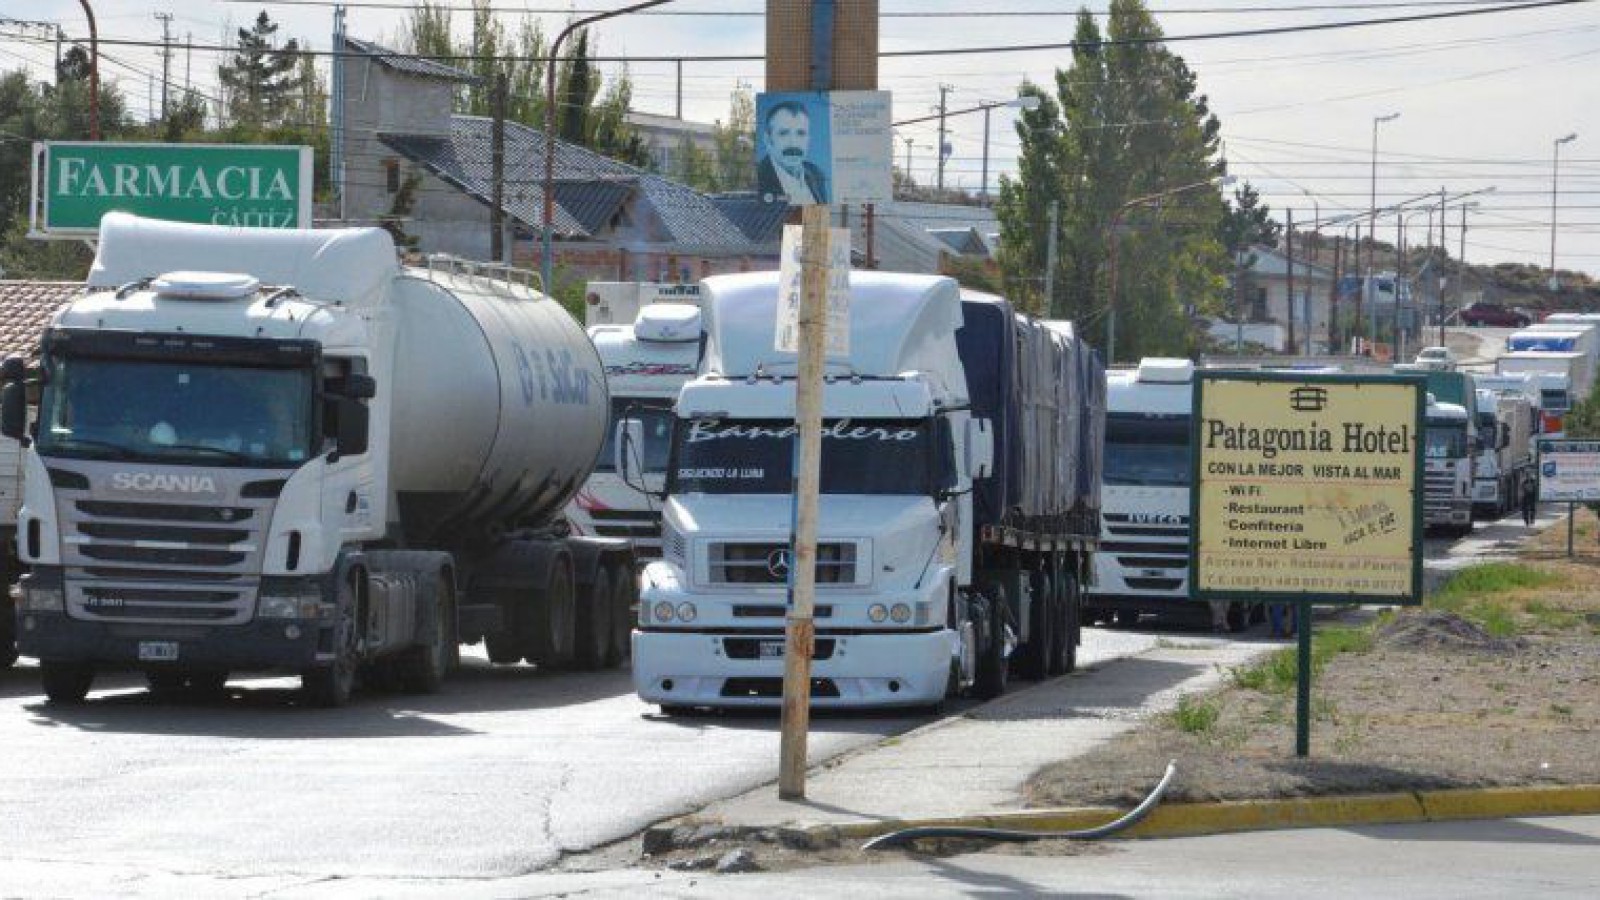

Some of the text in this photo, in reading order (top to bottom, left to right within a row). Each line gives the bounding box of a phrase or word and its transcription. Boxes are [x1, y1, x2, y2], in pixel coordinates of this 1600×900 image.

[56, 157, 293, 200] FARMACIA
[687, 419, 918, 442] Banlero
[1207, 419, 1409, 458] Patagonia Hotel
[1208, 462, 1401, 479] CON LA MEJOR VISTA AL MAR
[113, 472, 216, 494] SCANIA
[1294, 539, 1327, 550] Libre
